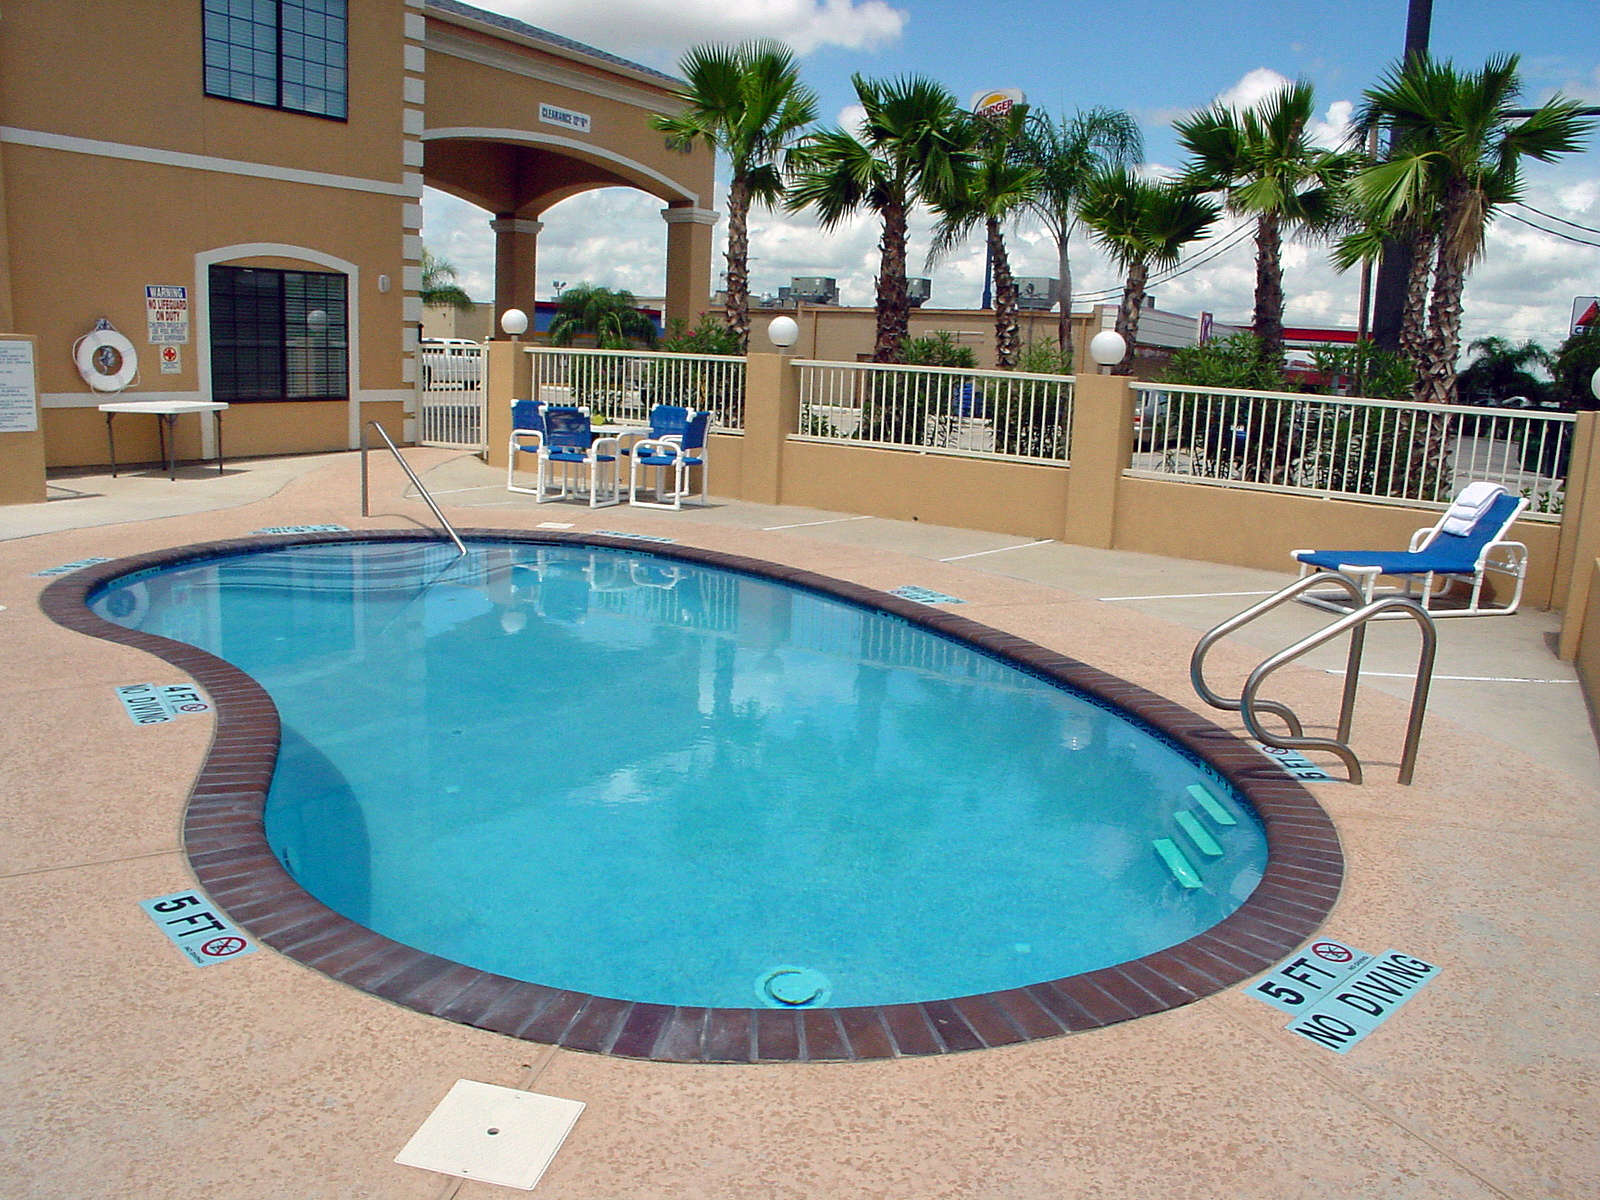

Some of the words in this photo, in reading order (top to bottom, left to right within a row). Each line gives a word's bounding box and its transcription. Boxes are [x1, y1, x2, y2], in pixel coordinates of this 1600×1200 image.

[541, 107, 572, 124] CLEARANCE
[150, 287, 183, 298] WARNING
[148, 299, 156, 310] NO
[157, 300, 187, 310] LIFEGUARD
[156, 311, 164, 321] ON
[165, 311, 181, 321] DUTY
[119, 684, 151, 694] NO
[168, 693, 200, 703] FT
[127, 696, 169, 724] DIVING
[153, 895, 201, 913] 5
[166, 911, 227, 937] FT
[1280, 956, 1337, 991] FT
[1257, 980, 1305, 1006] 5
[1294, 1013, 1358, 1050] NO
[1336, 954, 1435, 1017] DIVING
